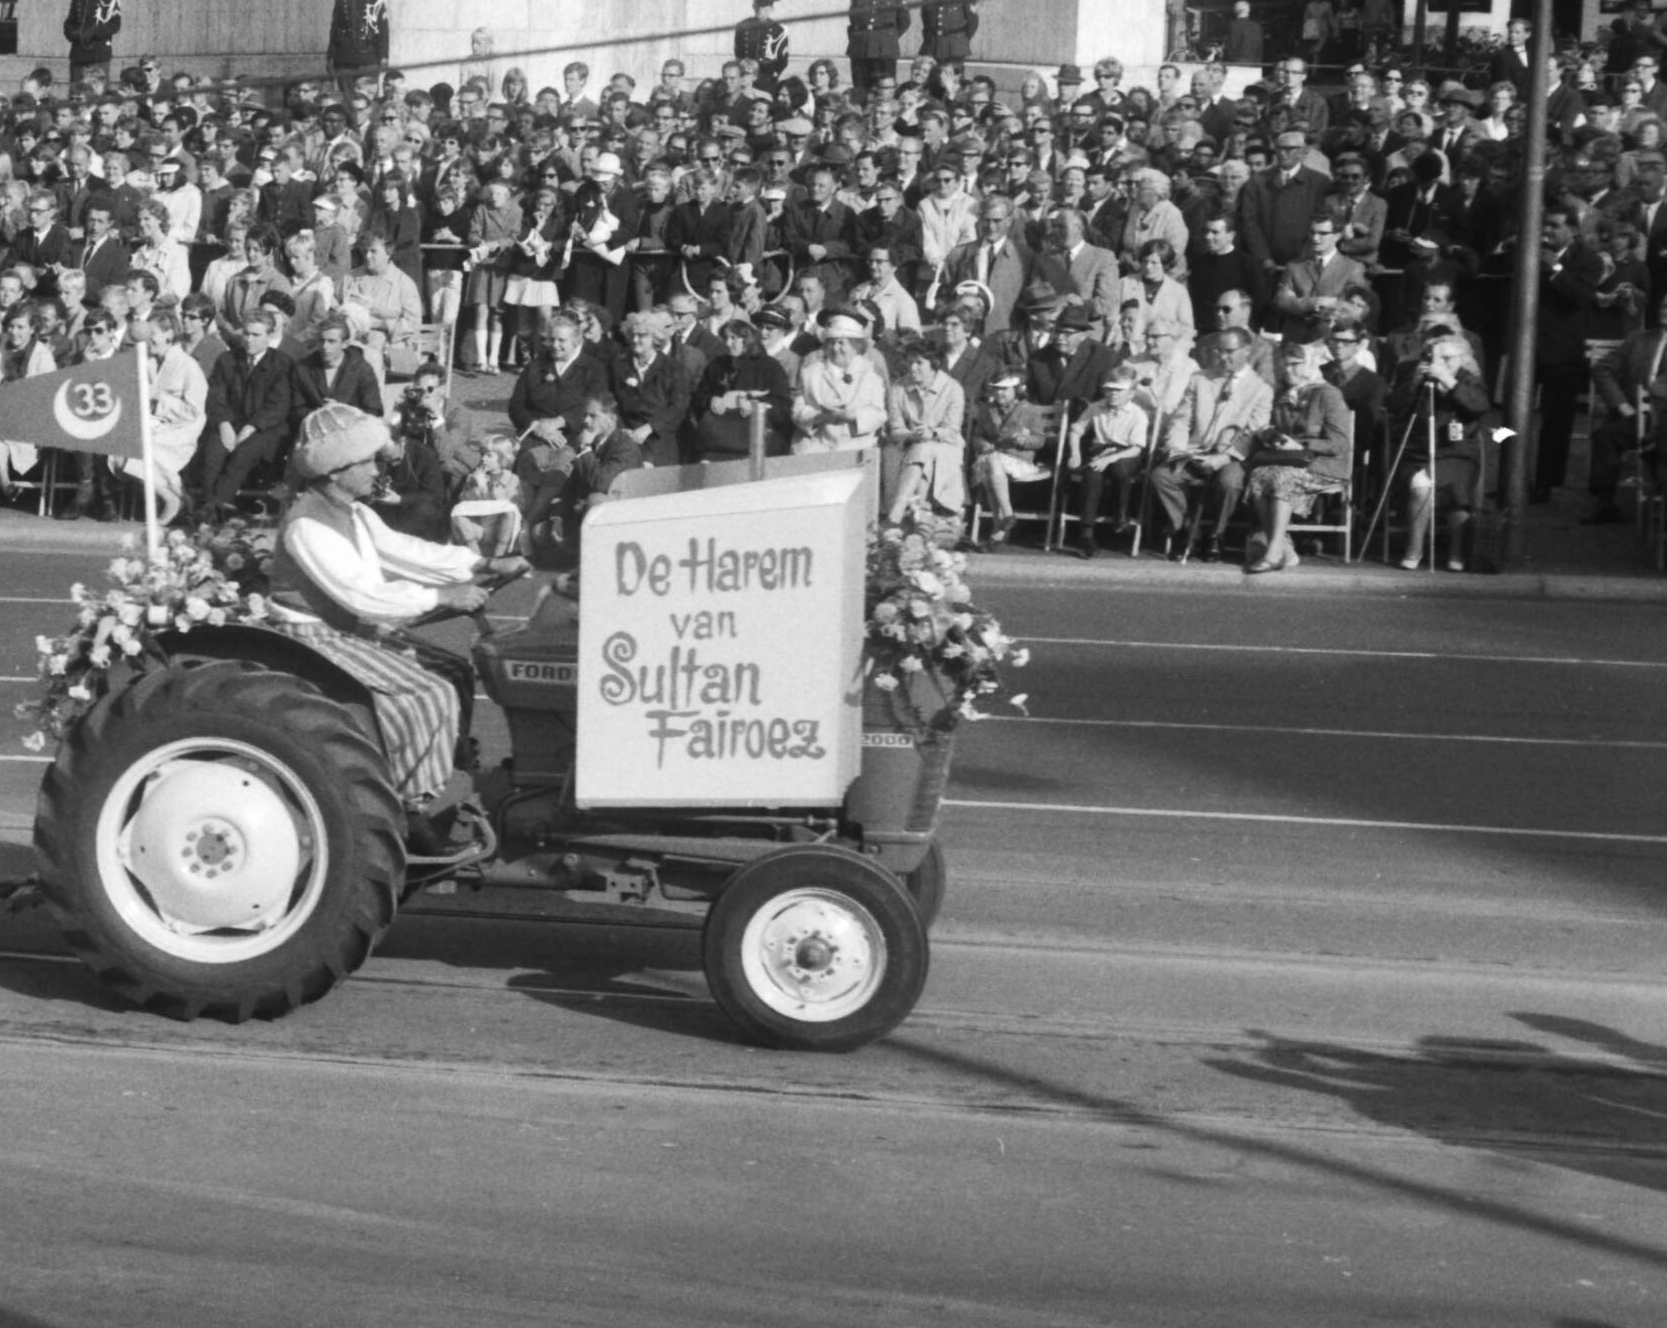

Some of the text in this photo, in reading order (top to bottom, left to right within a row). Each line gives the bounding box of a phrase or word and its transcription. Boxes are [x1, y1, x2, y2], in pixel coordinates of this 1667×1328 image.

[72, 382, 114, 417] 33
[615, 537, 813, 596] De Harem
[669, 610, 738, 640] van
[511, 663, 572, 681] FORD
[599, 631, 762, 710] Sultan
[645, 709, 826, 770] Fairoez
[861, 734, 910, 746] 2000
